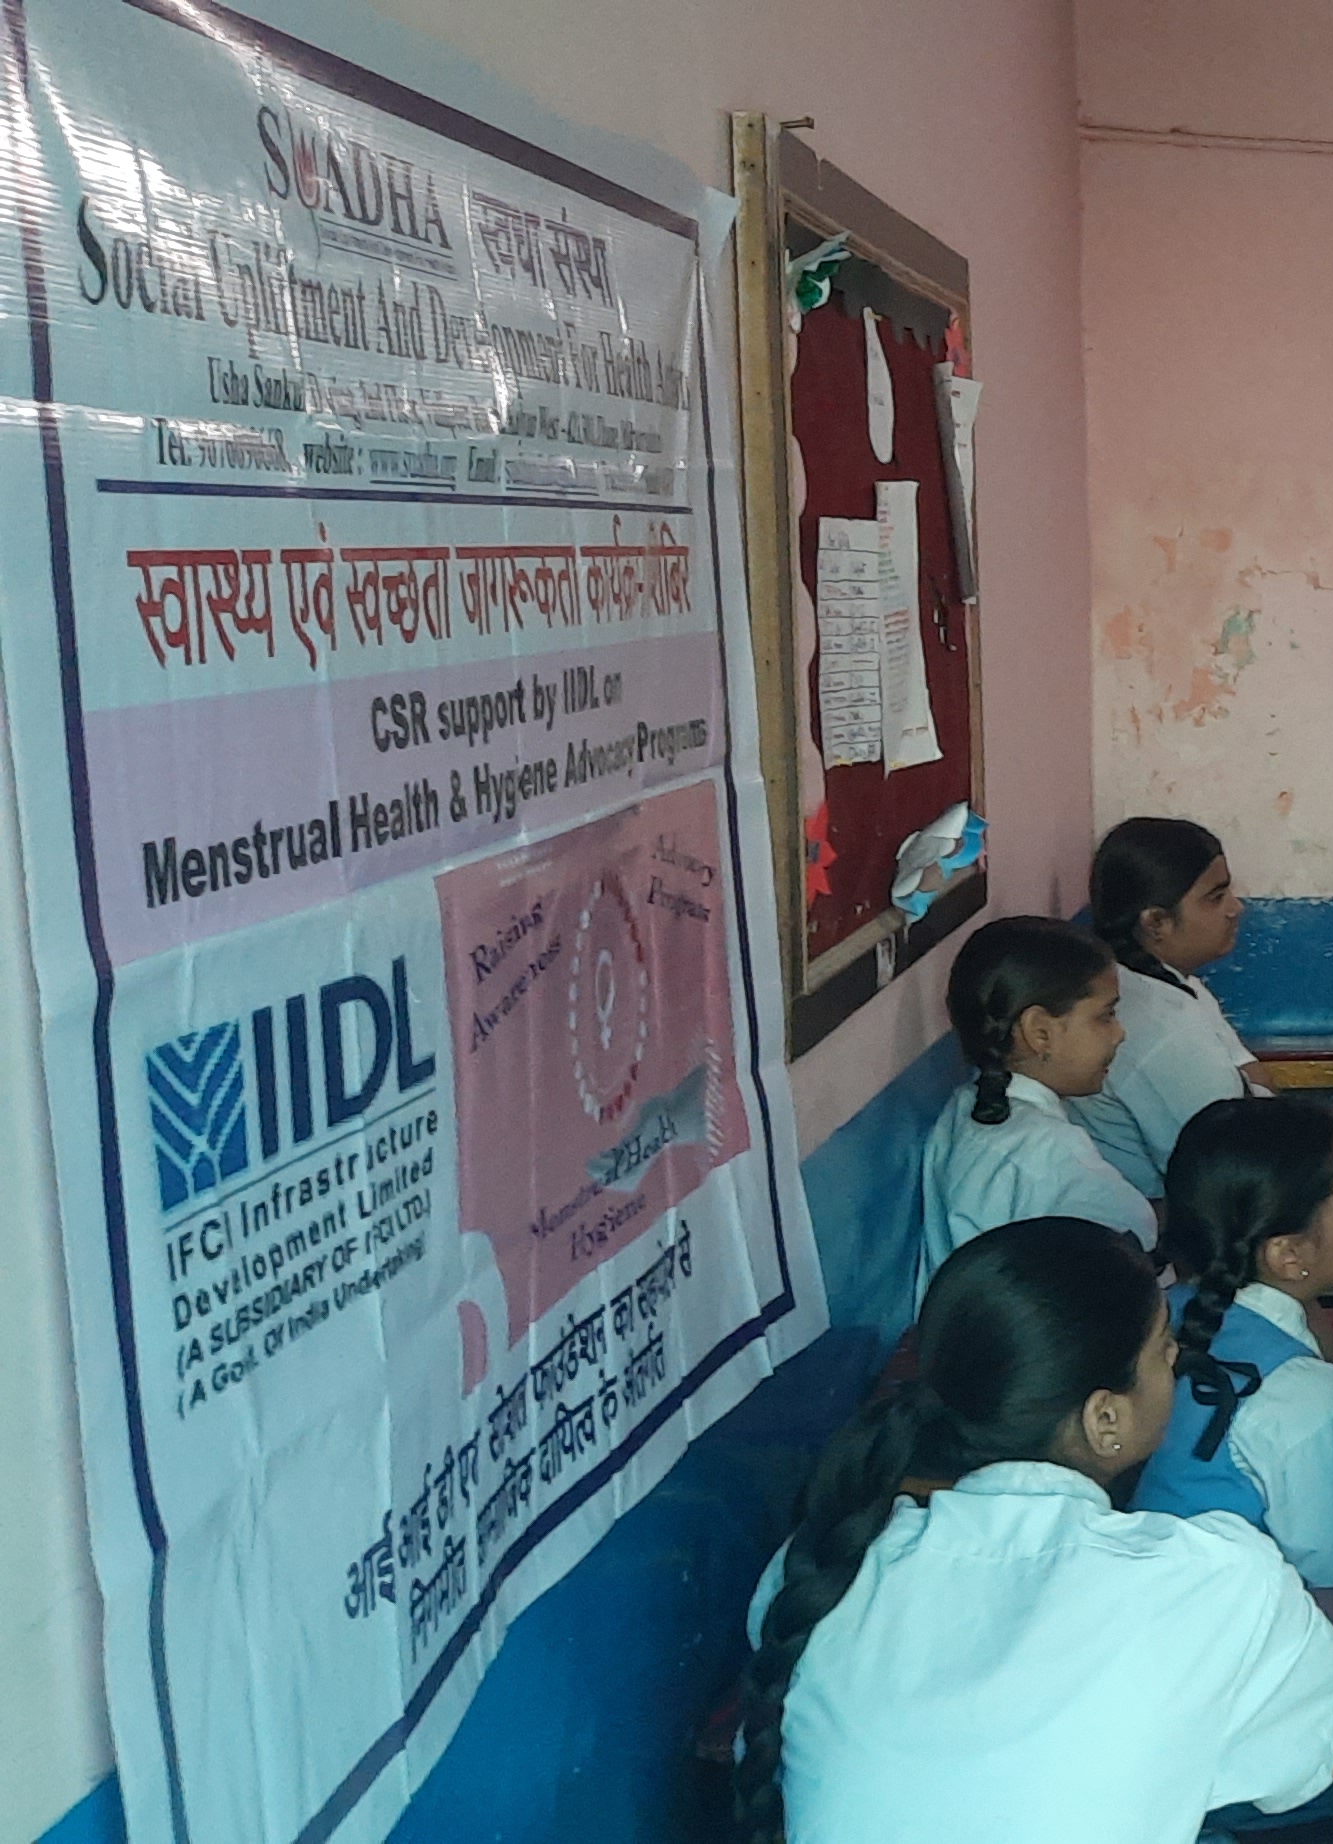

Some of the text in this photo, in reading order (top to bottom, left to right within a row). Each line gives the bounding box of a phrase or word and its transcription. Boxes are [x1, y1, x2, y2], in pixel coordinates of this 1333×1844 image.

[126, 548, 274, 669] स्वास्थ्य
[280, 521, 336, 670] एवं
[340, 546, 450, 646] स्वच्छता
[455, 545, 581, 635] जागरूकता
[370, 691, 430, 753] CSR
[437, 678, 526, 748] support
[531, 677, 557, 731] by
[562, 664, 600, 715] IIDL
[142, 799, 341, 908] Menstrual
[350, 777, 439, 853] Health
[448, 775, 468, 823] &
[473, 751, 558, 824] Hygiene
[251, 954, 436, 1160] IIDL
[167, 1210, 233, 1282] IFCI
[173, 1146, 434, 1332] Development Limited
[330, 1235, 359, 1274] OF
